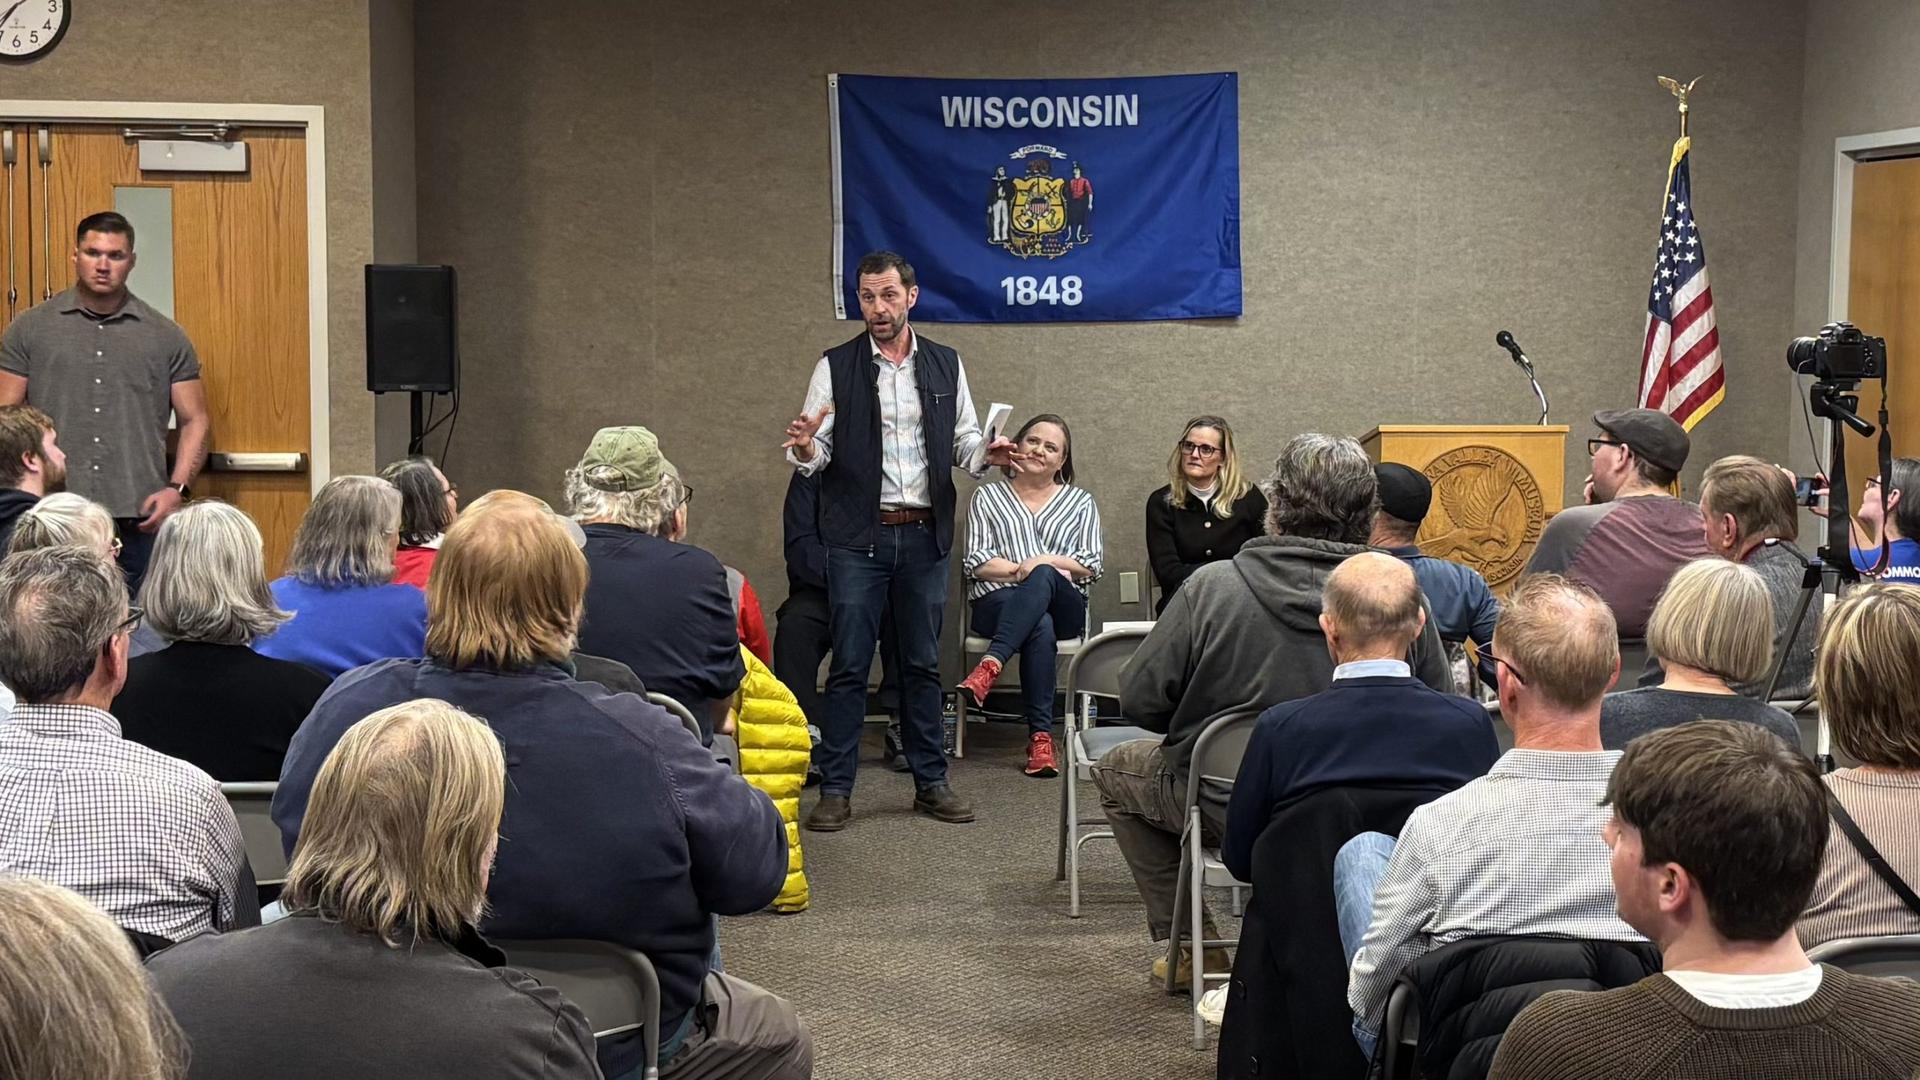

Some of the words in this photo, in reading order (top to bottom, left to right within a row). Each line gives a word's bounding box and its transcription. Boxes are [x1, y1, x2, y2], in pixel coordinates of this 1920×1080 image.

[48, 0, 57, 13] 3
[42, 18, 51, 30] 4
[12, 34, 21, 48] 6
[30, 30, 38, 43] 5
[941, 94, 1138, 128] WISCONSIN
[1001, 275, 1083, 306] 1848
[1875, 566, 1920, 579] OMMO
